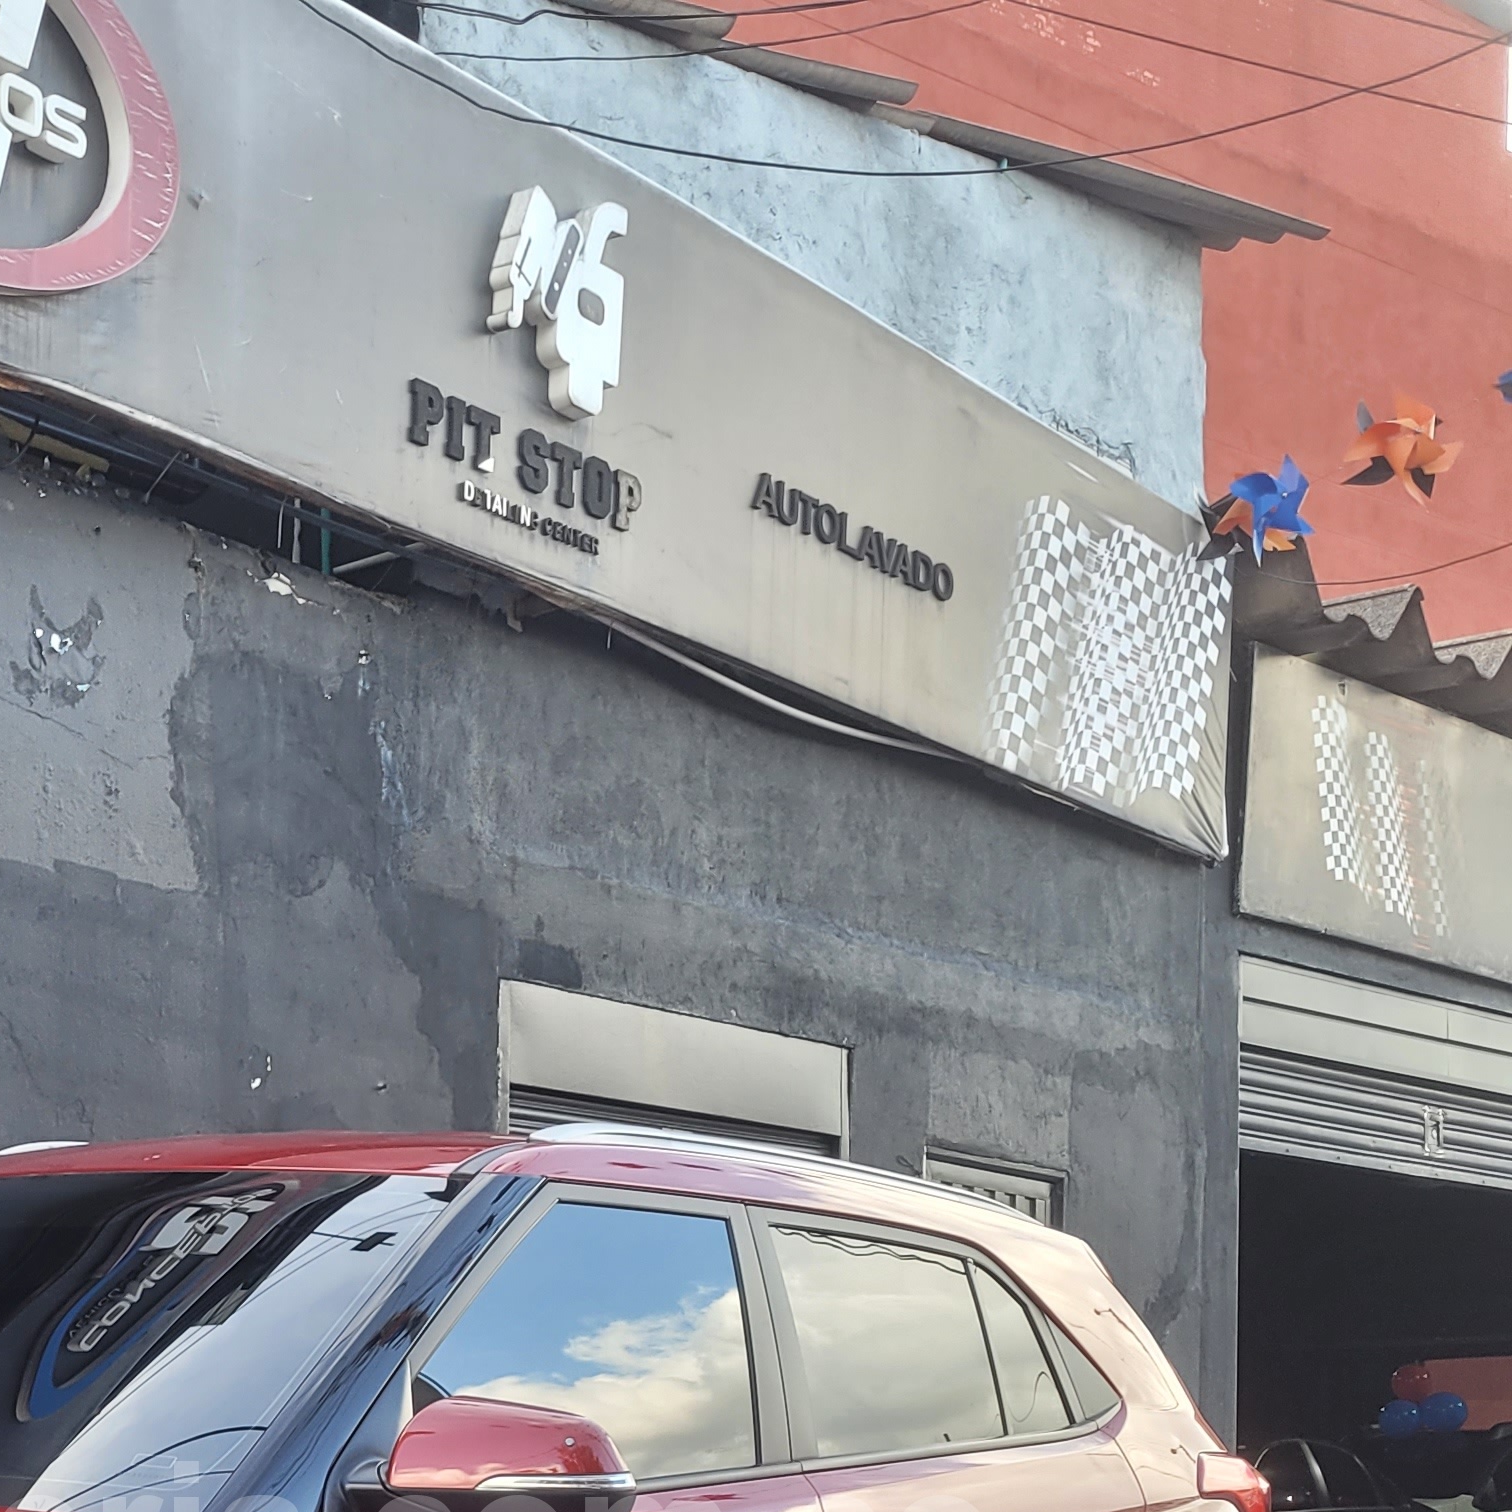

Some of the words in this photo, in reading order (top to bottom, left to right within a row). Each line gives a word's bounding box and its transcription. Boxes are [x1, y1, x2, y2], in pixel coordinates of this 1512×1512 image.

[408, 377, 501, 473] PIT
[518, 428, 643, 532] STOP
[540, 517, 600, 556] CENTER
[750, 472, 954, 601] AUTOLAVADO
